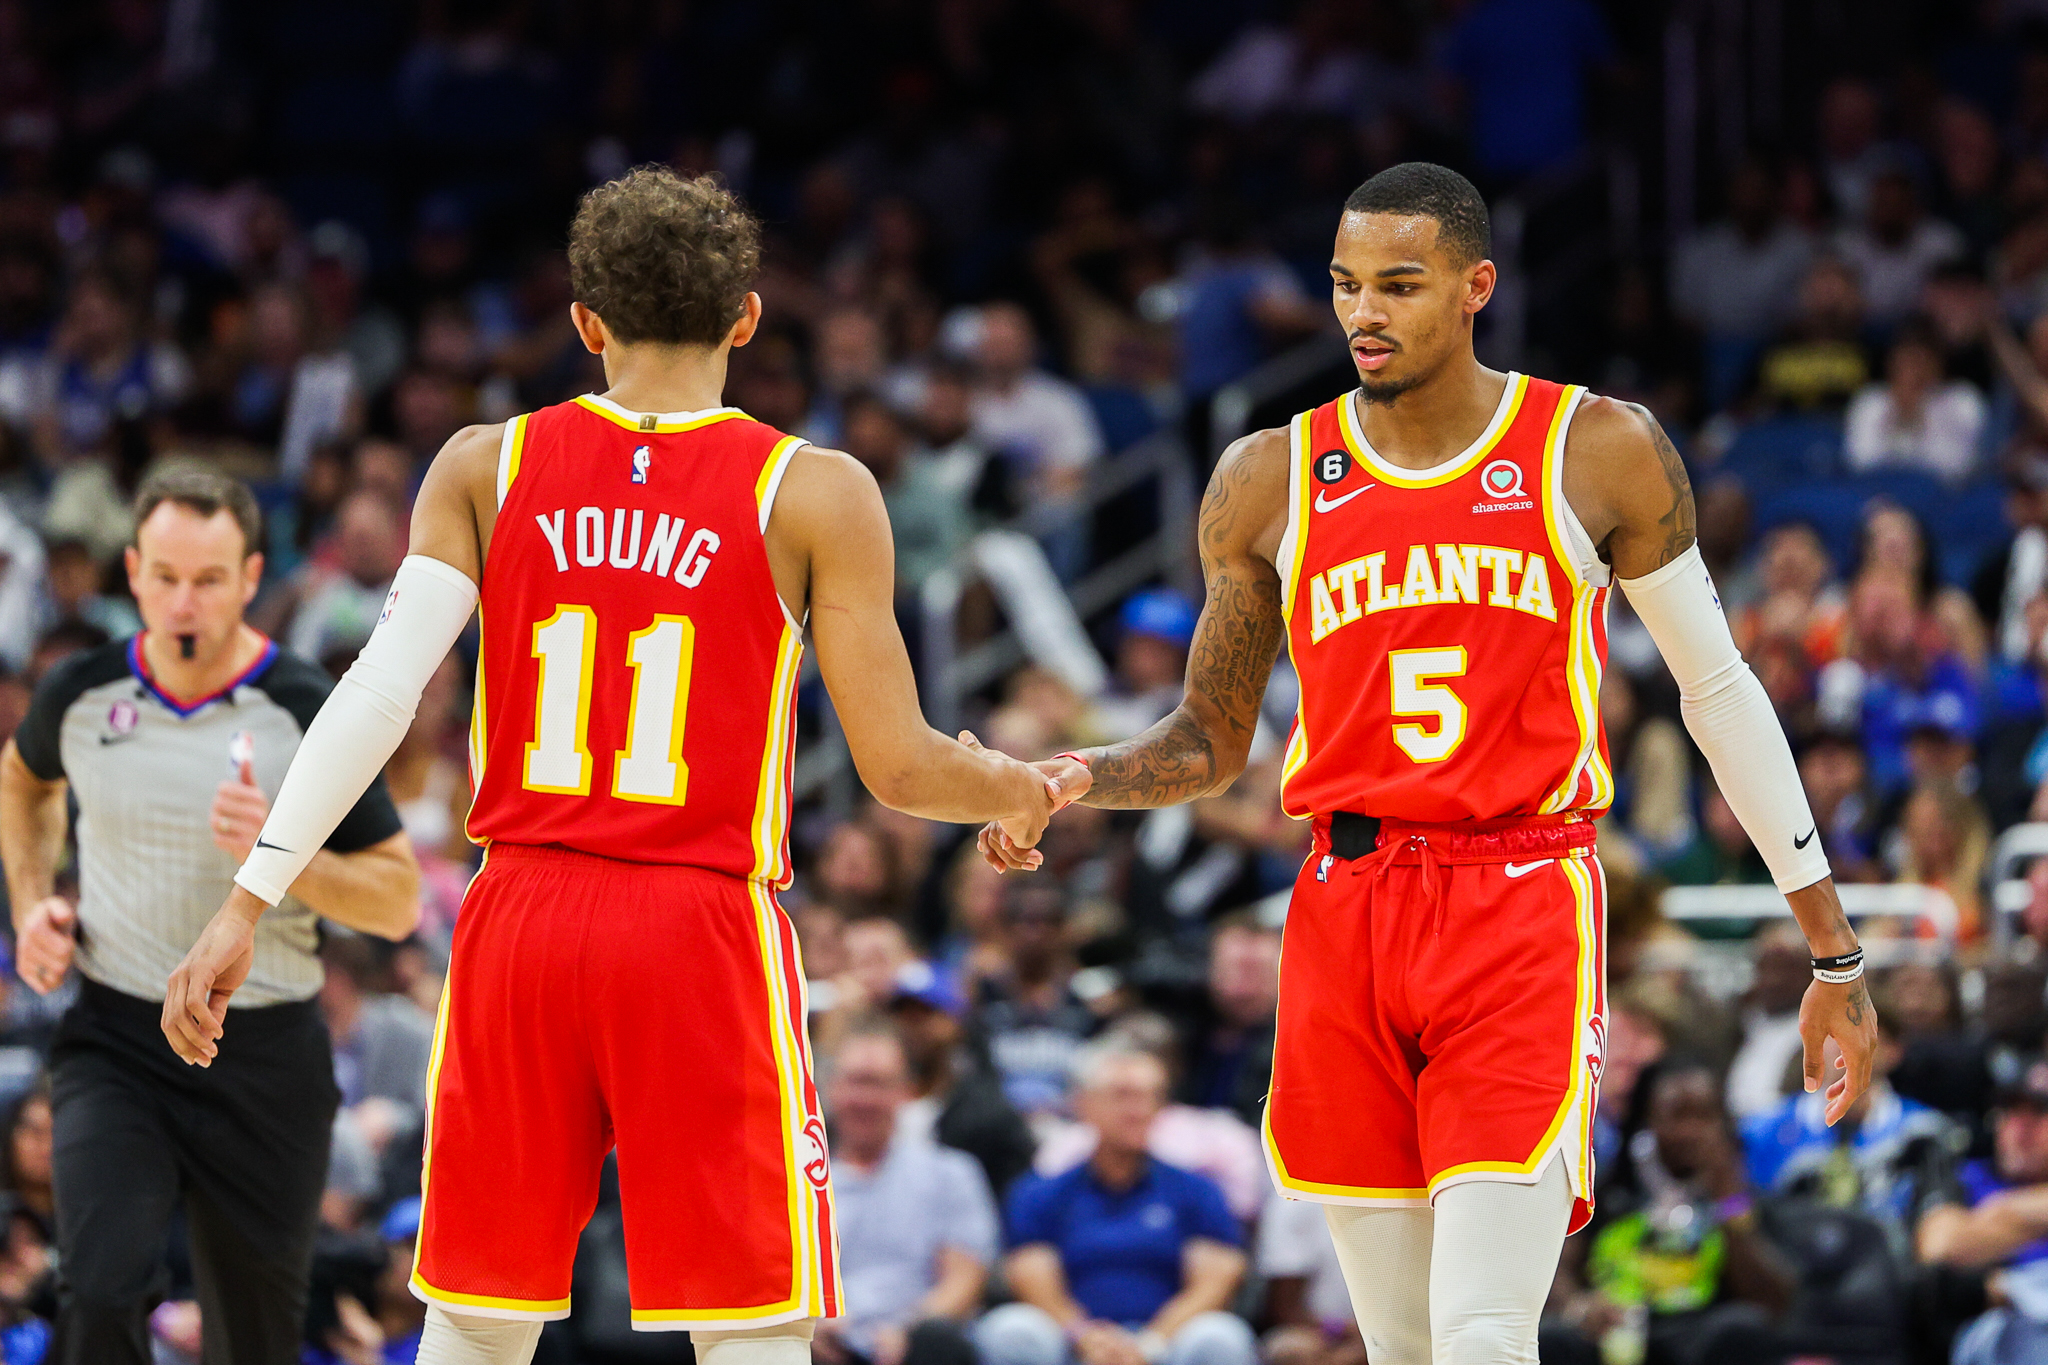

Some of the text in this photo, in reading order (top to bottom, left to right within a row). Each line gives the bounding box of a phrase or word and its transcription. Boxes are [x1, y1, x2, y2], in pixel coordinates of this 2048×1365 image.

[1323, 454, 1343, 481] 6
[1472, 499, 1533, 514] sharecare
[535, 506, 720, 589] YOUNG
[1310, 543, 1558, 646] ATLANTA
[522, 603, 695, 806] 11
[1224, 649, 1243, 692] Nothing
[1388, 645, 1467, 763] 5
